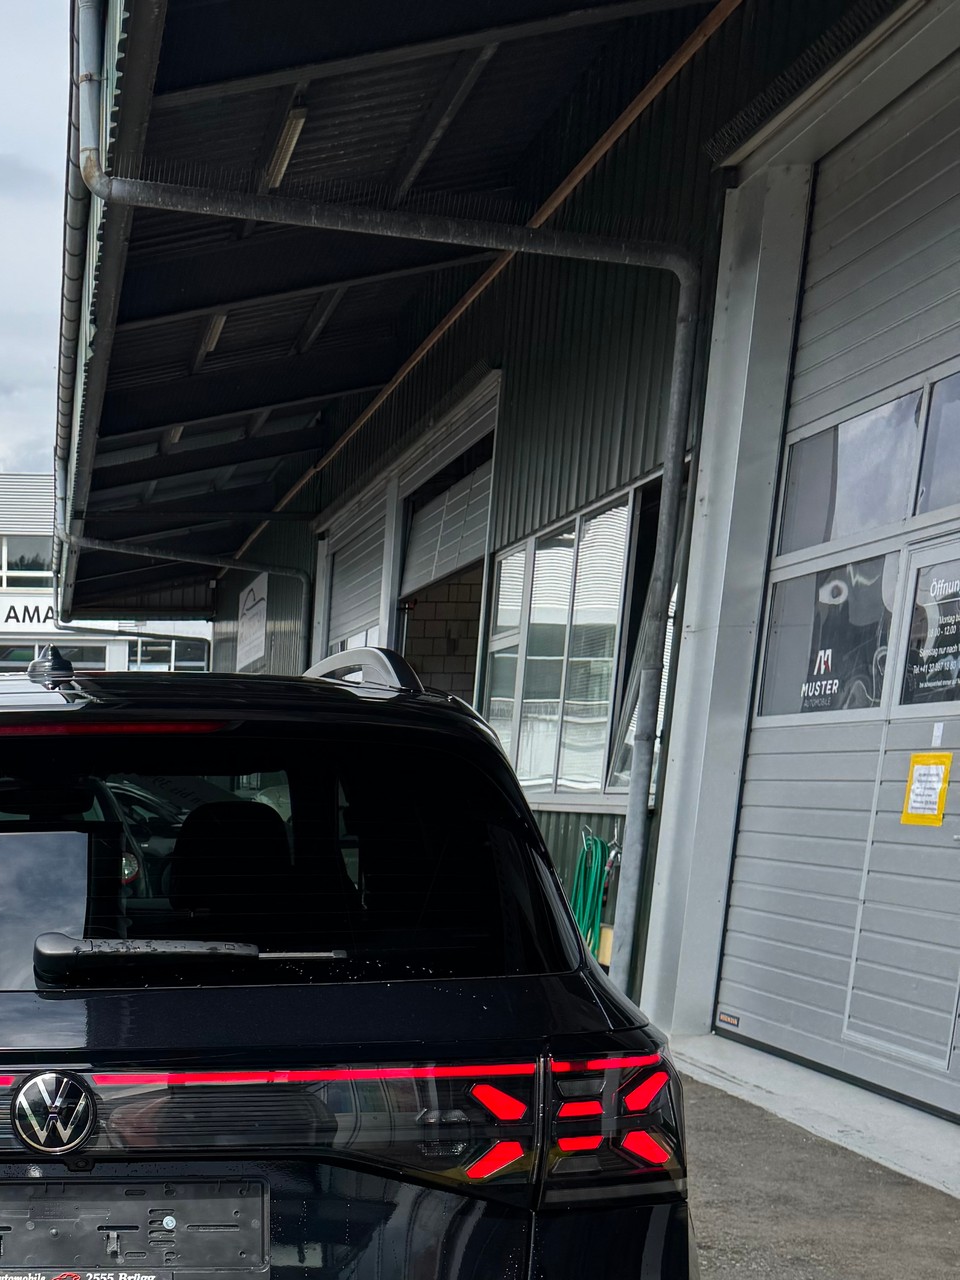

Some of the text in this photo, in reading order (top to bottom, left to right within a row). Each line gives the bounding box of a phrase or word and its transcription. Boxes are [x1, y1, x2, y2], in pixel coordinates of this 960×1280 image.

[930, 578, 960, 596] Öffnun
[4, 605, 58, 623] AMA
[801, 679, 839, 697] MUSTER
